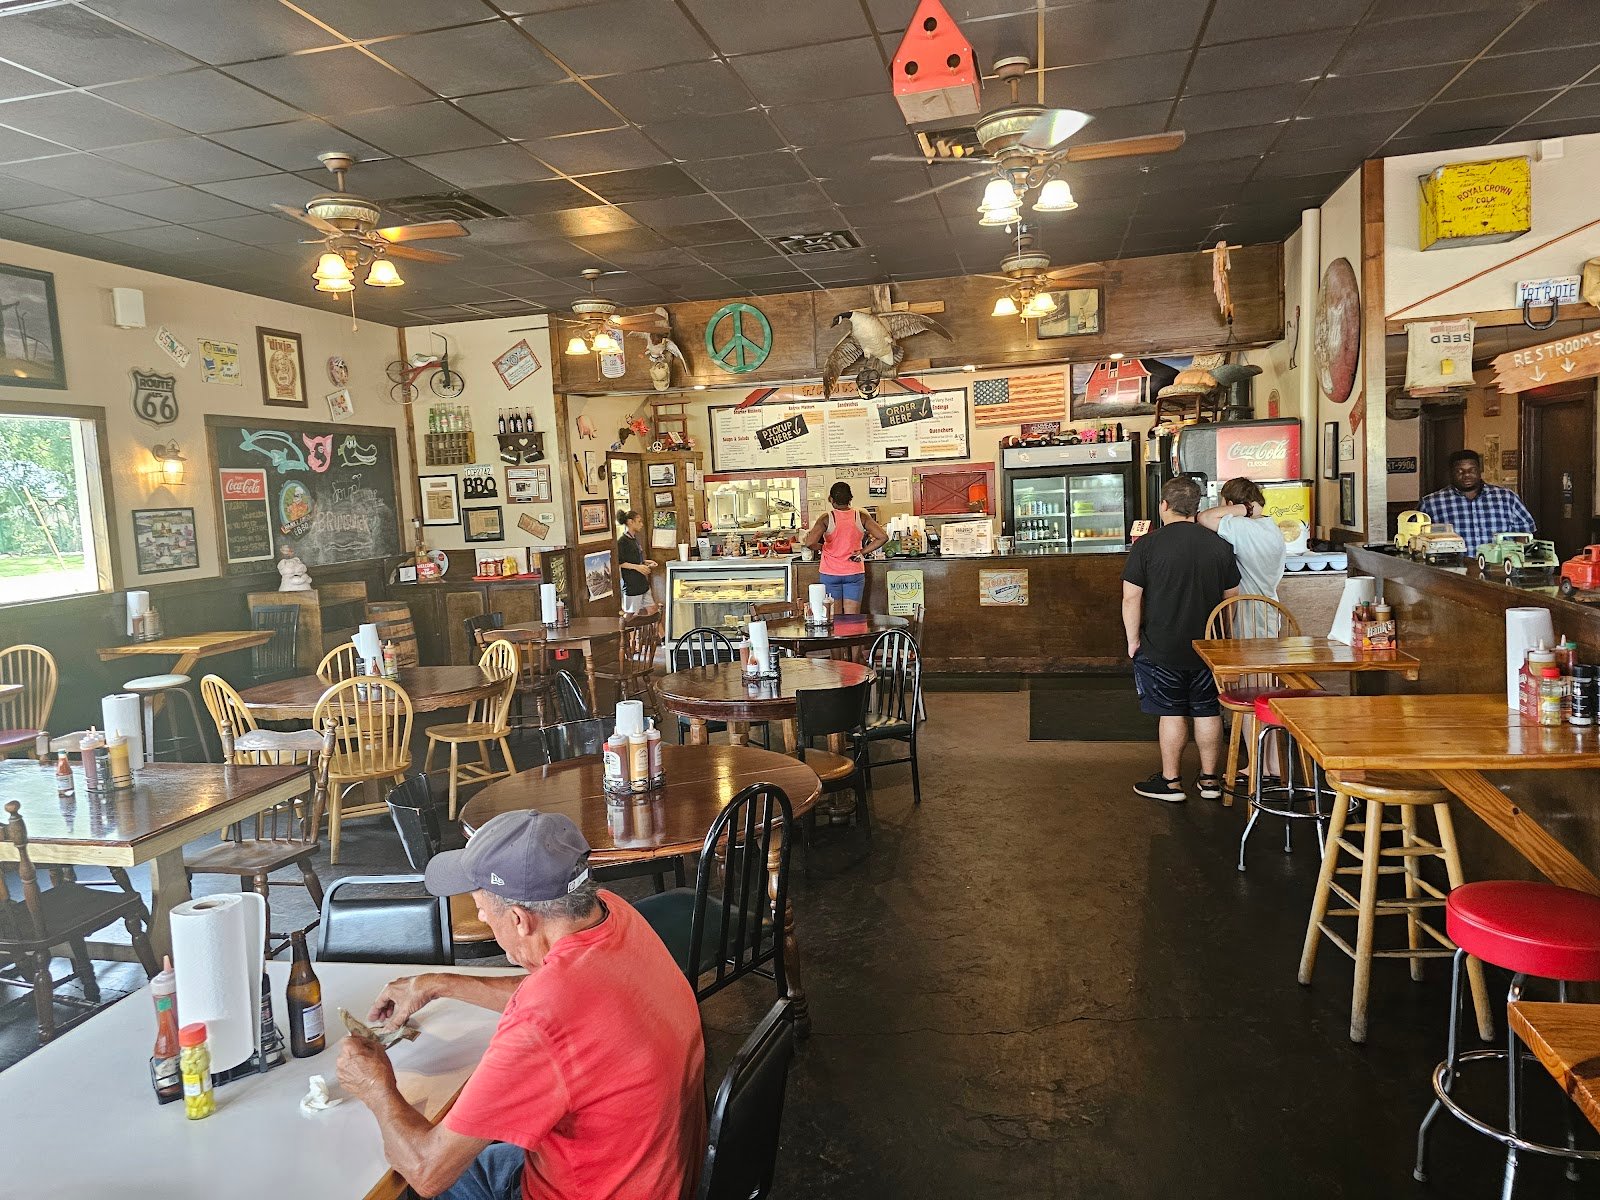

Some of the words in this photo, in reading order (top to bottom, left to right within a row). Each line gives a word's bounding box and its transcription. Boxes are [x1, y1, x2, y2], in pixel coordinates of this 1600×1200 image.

[1457, 185, 1483, 202] ROYAL
[1484, 184, 1513, 196] CROWN
[1476, 196, 1495, 204] COLA
[1513, 332, 1600, 368] RESTROOMS
[140, 378, 173, 390] ROUTE
[142, 392, 175, 420] 66
[886, 402, 916, 416] ORDER
[890, 412, 912, 425] HERE
[762, 421, 792, 439] PICKUP
[766, 431, 794, 446] THERE
[1228, 440, 1289, 460] Coca-Cola
[463, 476, 497, 494] BBQ
